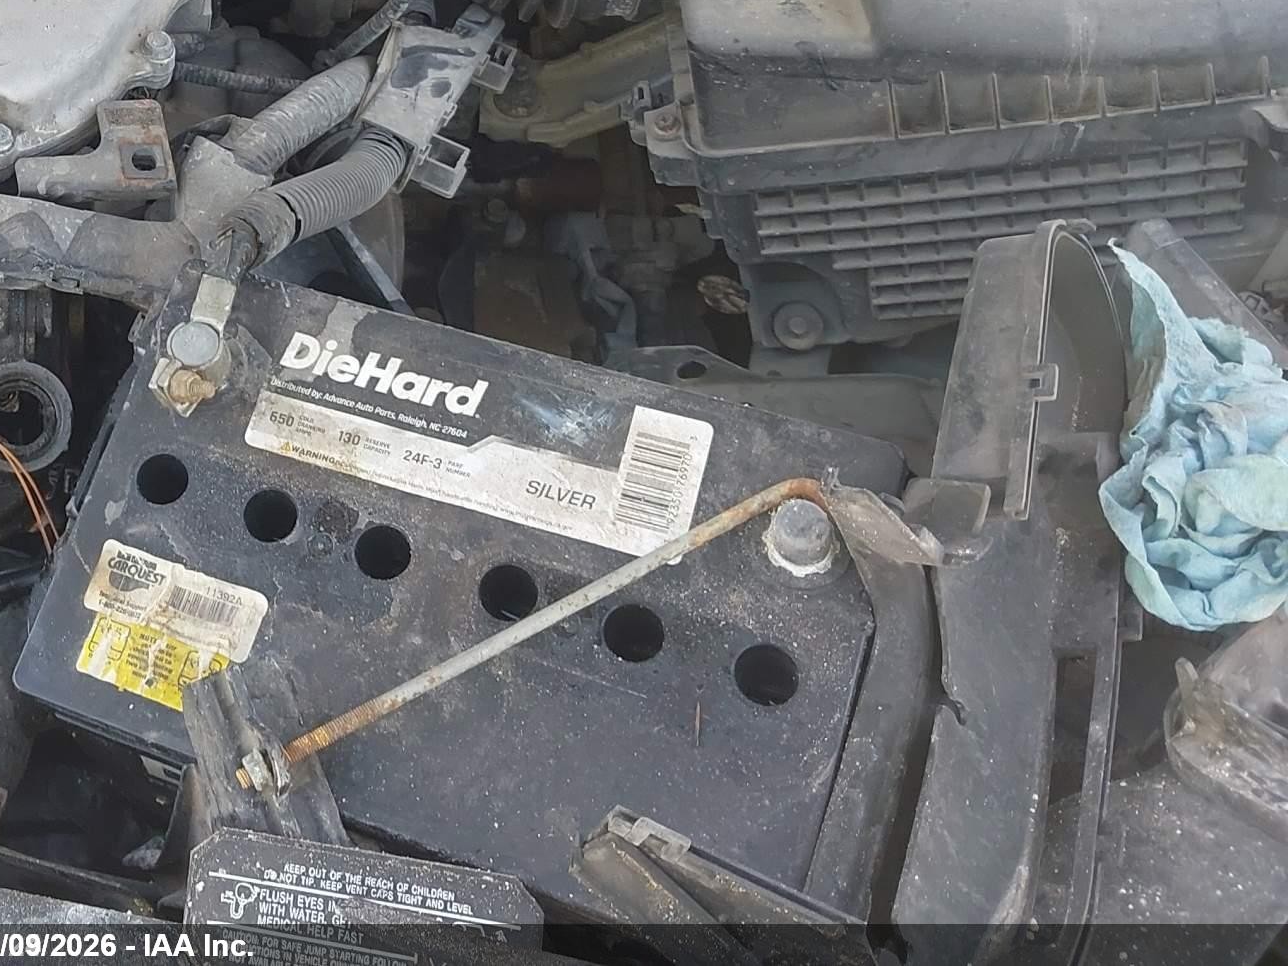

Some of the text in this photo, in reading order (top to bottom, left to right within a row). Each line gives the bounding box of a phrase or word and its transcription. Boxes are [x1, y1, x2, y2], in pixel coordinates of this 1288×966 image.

[279, 331, 489, 417] DieHard
[269, 411, 295, 427] 650
[270, 376, 468, 439] Distributed by: Advance Auto Parts, Raleigh, NC 27604
[338, 430, 361, 446] 130
[403, 449, 443, 470] 24F-3
[525, 480, 596, 510] SILVER
[108, 557, 167, 586] CARQUEST
[205, 586, 242, 606] 11392A
[279, 872, 297, 883] NOT
[320, 880, 343, 891] KEEP
[345, 883, 368, 896] VENT
[371, 888, 394, 901] CAPS
[397, 893, 423, 906] TIGHT
[426, 899, 444, 910] AND
[447, 902, 474, 915] LEVEL
[284, 863, 455, 901] KEEP OUT OF THE REACH OF CHILDREN
[259, 888, 293, 904] FLUSH
[297, 895, 324, 910] EYES
[259, 902, 285, 916] WITH
[257, 914, 364, 945] MEDICAL HELP FAST
[262, 936, 279, 948] FOR
[281, 939, 302, 953] SAFE
[304, 945, 327, 956] JUMP
[329, 948, 370, 965] STARTING
